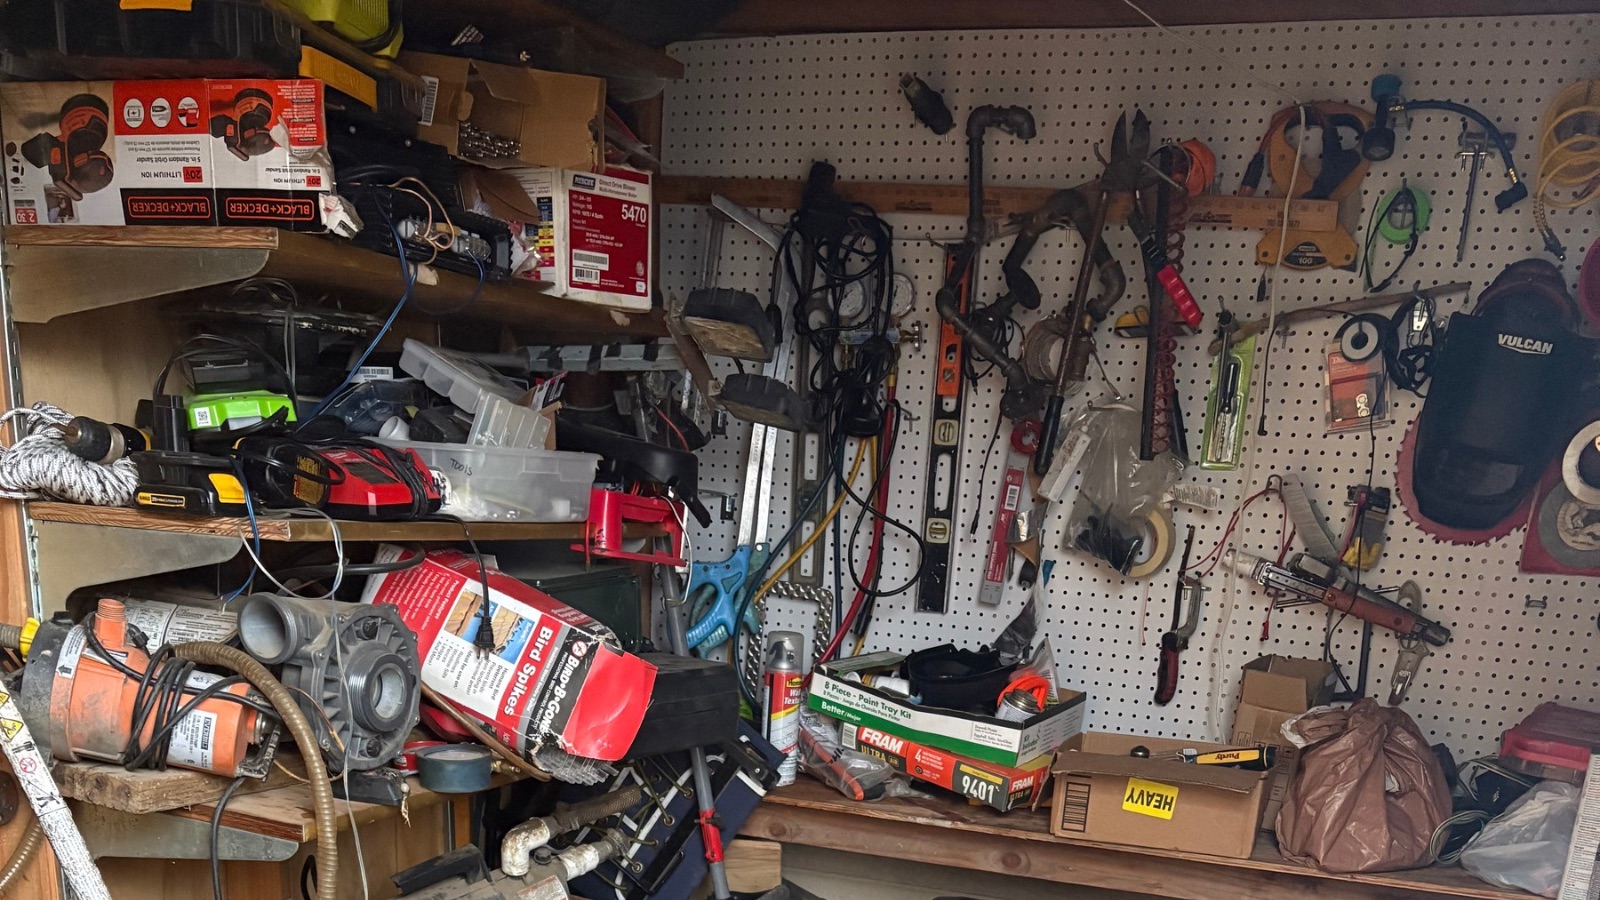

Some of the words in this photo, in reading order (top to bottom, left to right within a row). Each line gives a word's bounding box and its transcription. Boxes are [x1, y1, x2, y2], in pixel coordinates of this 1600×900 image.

[132, 202, 206, 213] BLACK+DECKER
[230, 203, 310, 215] BLACK+DECKER
[621, 203, 646, 223] 5470
[1498, 334, 1553, 353] VULCAN
[445, 578, 459, 598] Product
[433, 597, 448, 619] Features
[433, 640, 442, 651] And
[434, 642, 447, 660] Ledges
[531, 626, 553, 661] Bird
[426, 650, 437, 665] More!
[441, 645, 453, 663] Fences
[445, 647, 458, 668] Window
[463, 649, 473, 663] Ideal
[459, 662, 467, 671] for
[483, 661, 496, 680] Prevent
[550, 651, 569, 680] PROFESSIONAL
[455, 670, 463, 680] use
[472, 670, 485, 689] landing
[487, 664, 503, 689] Deterrent
[494, 667, 508, 688] Humane
[478, 680, 488, 693] birds
[505, 662, 537, 715] Spikes
[546, 679, 555, 690] BIRD
[490, 688, 499, 700] Bird
[823, 681, 830, 689] 8
[830, 683, 852, 697] Piece
[857, 693, 879, 707] Paint
[879, 702, 898, 715] Tray
[899, 709, 912, 719] Kit
[841, 697, 855, 706] Juego
[861, 727, 904, 755] FRAM
[861, 745, 886, 762] ULTRA
[914, 748, 922, 762] 4
[1215, 753, 1240, 762] Purdy
[962, 776, 996, 804] 9401
[1012, 776, 1034, 790] FRAM
[1125, 787, 1174, 812] HEAVY
